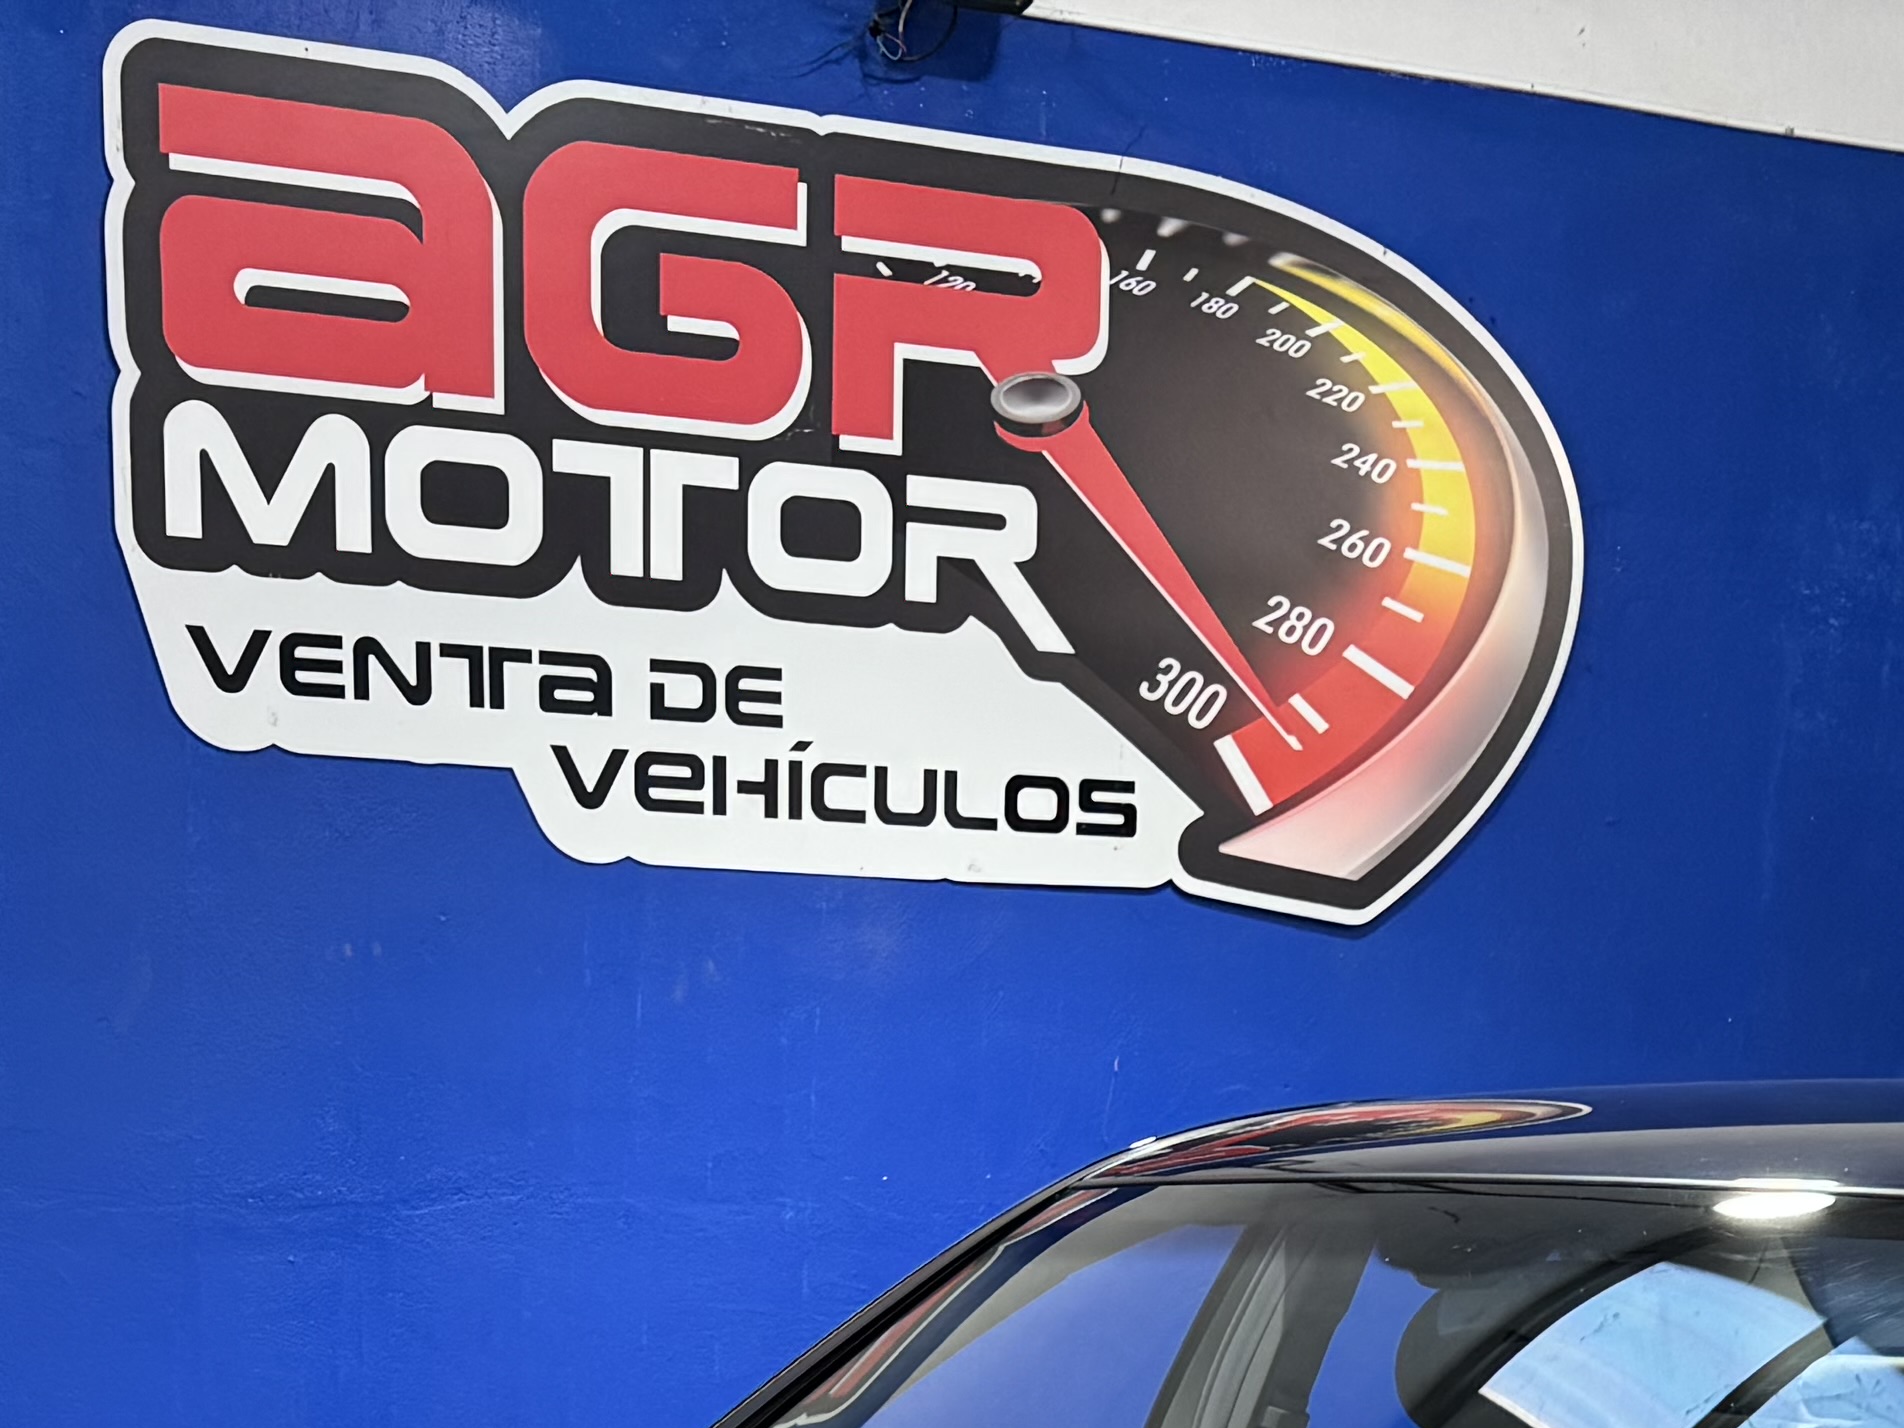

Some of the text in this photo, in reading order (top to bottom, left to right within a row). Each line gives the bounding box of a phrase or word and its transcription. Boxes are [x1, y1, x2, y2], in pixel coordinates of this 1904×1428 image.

[1110, 270, 1157, 296] 160
[1190, 292, 1239, 320] 180
[1256, 328, 1312, 358] 200
[1306, 378, 1365, 413] 220
[1331, 443, 1397, 484] 240
[163, 400, 1075, 655] MOTOR
[1317, 518, 1392, 568] 260
[1252, 595, 1335, 656] 280
[649, 658, 784, 729] DE
[1139, 657, 1228, 730] 300
